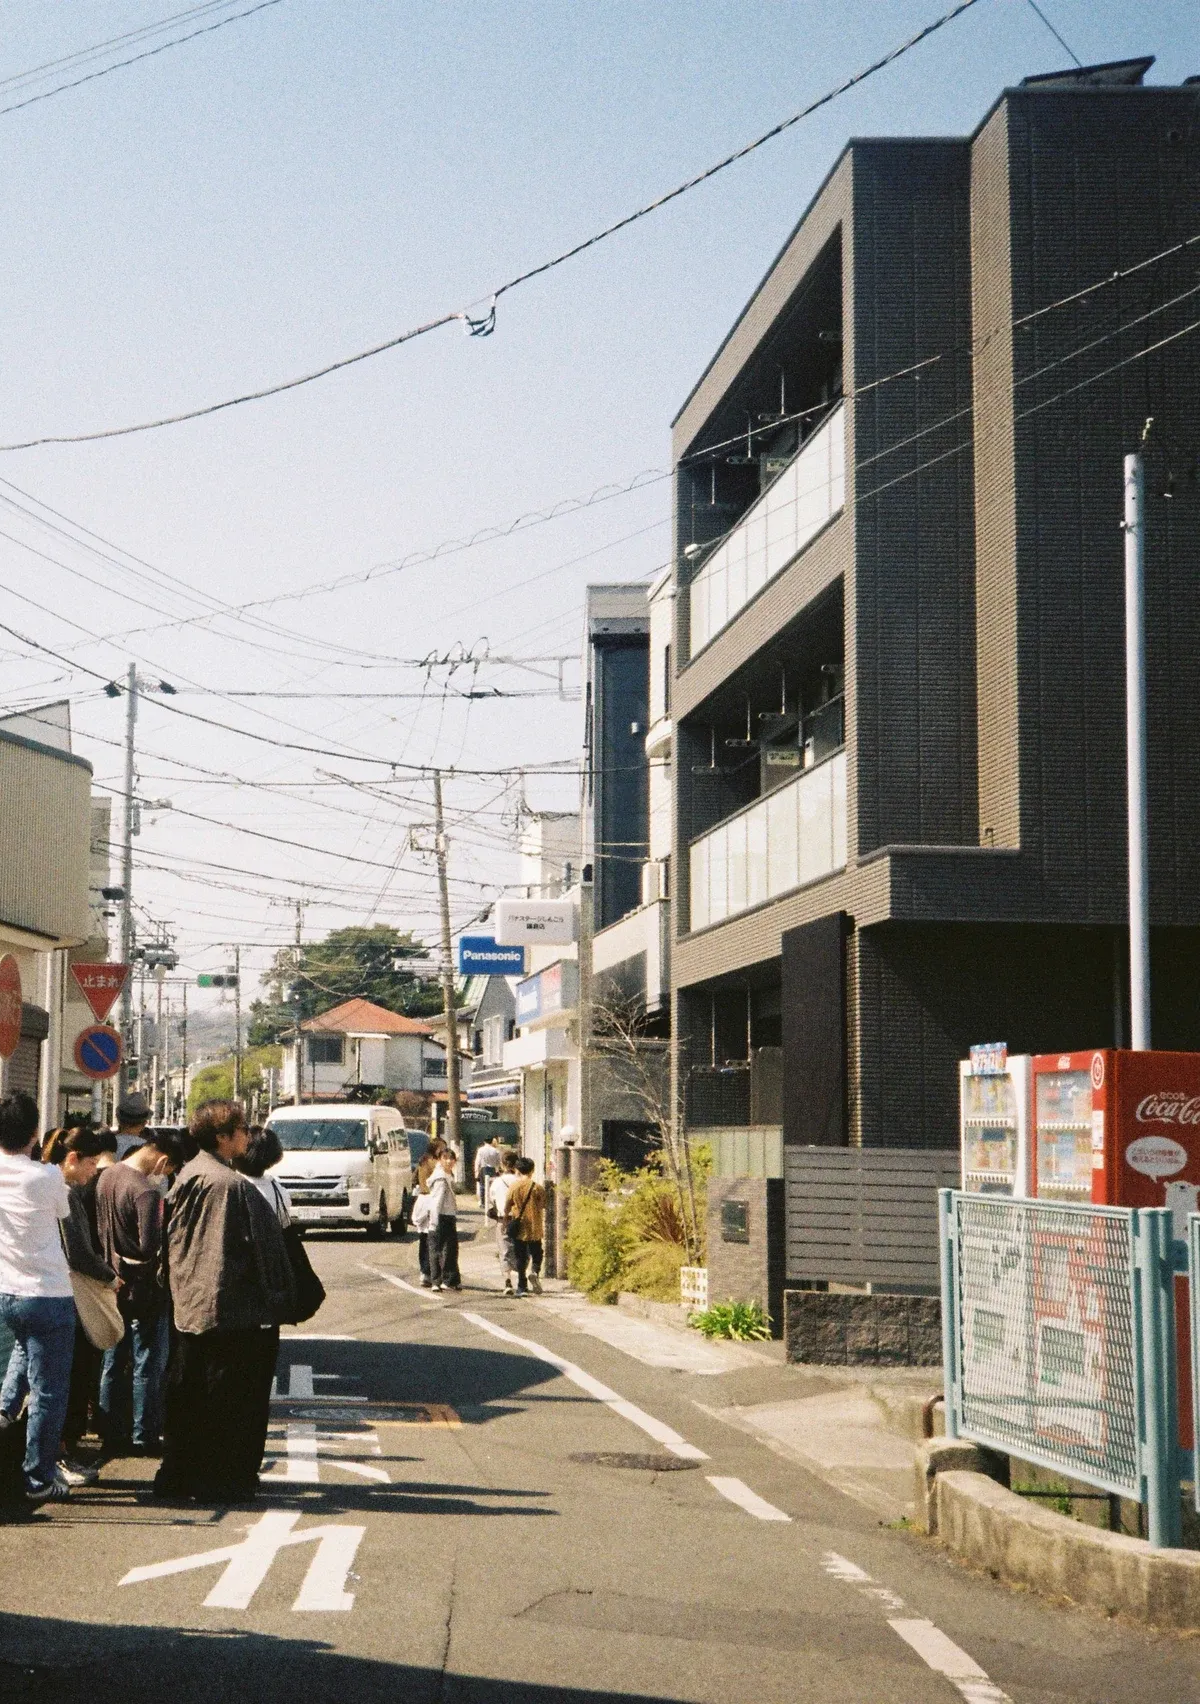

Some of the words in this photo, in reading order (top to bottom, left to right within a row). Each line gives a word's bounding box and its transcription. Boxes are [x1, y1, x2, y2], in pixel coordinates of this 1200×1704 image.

[462, 949, 521, 961] Panasonic
[82, 974, 120, 988] 止まれ
